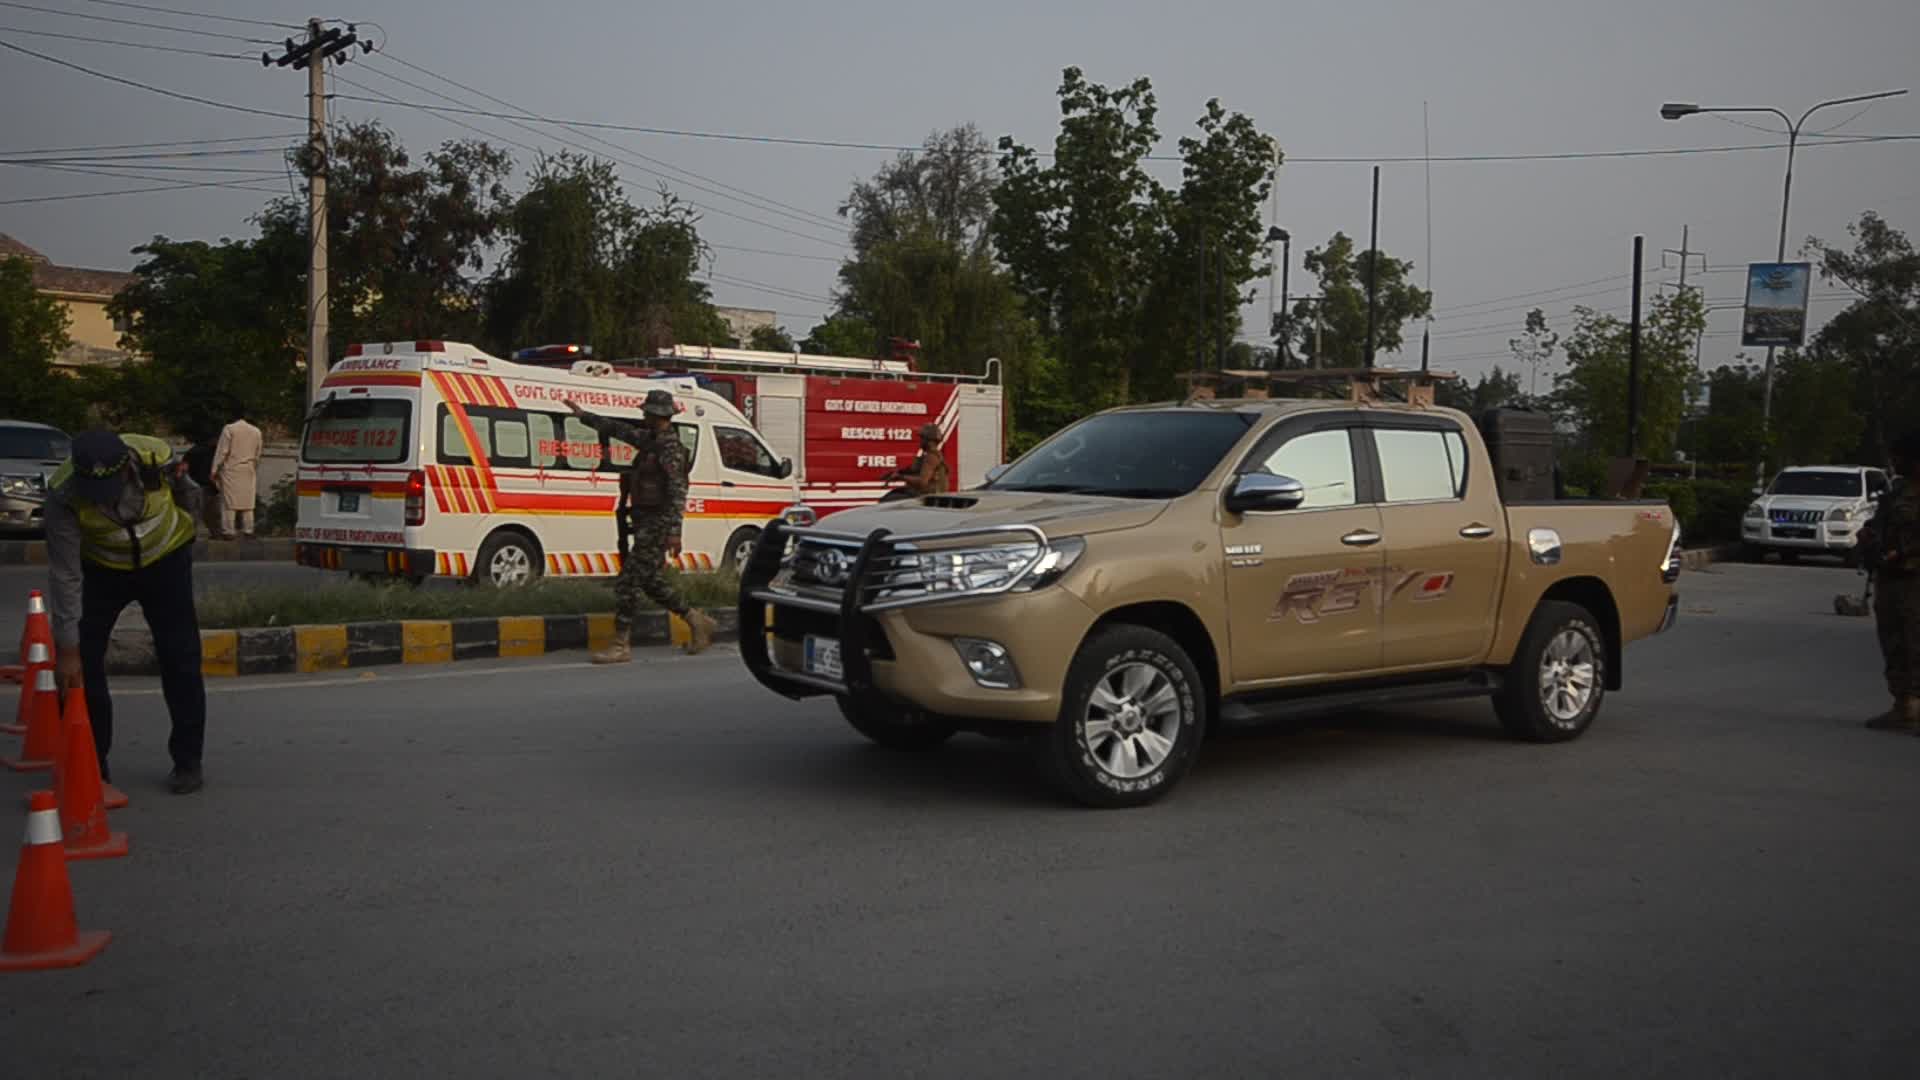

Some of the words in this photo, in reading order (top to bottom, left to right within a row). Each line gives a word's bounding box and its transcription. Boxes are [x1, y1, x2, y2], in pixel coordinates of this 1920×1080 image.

[339, 358, 401, 370] AMBULANCE
[514, 383, 547, 400] GOVT.
[549, 386, 564, 401] OF
[567, 389, 609, 408] KHYBER
[363, 427, 398, 448] 1122
[841, 426, 885, 440] RESCUE
[887, 428, 912, 441] 1122
[538, 438, 604, 461] RESCUE
[607, 442, 634, 463] 112
[857, 455, 897, 468] FIRE
